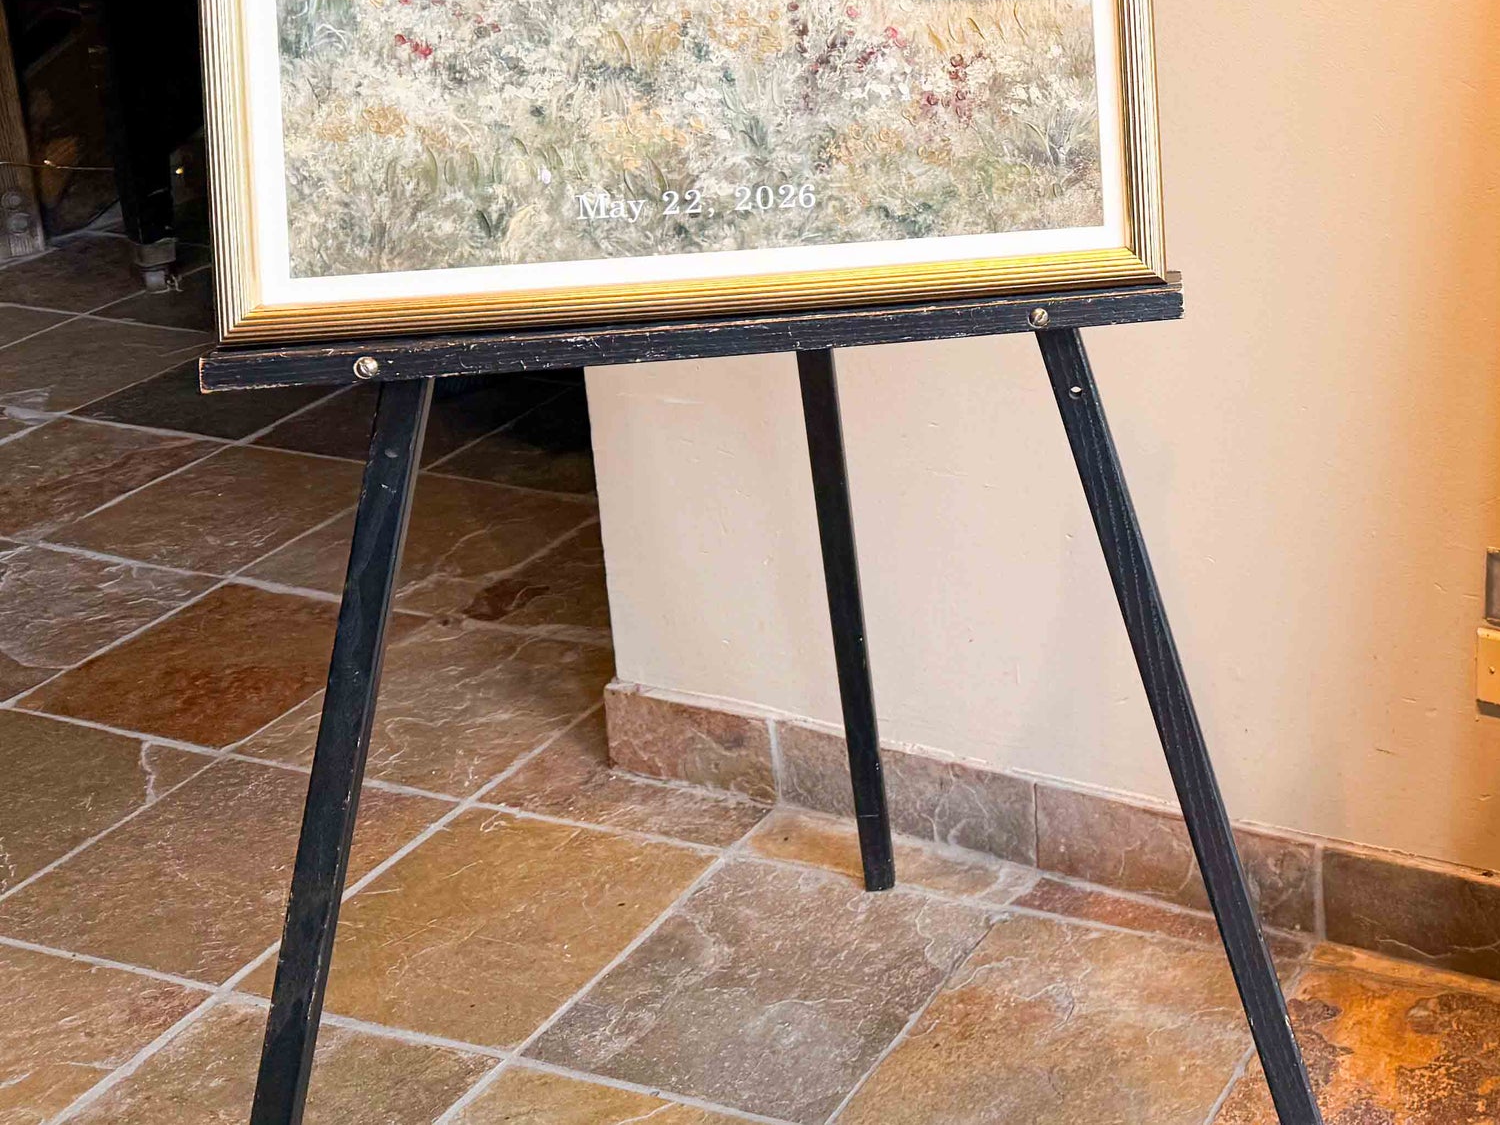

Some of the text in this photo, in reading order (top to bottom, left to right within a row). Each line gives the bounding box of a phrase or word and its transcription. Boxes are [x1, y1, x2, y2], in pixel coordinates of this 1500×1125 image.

[575, 184, 817, 223] May 22, 2026
